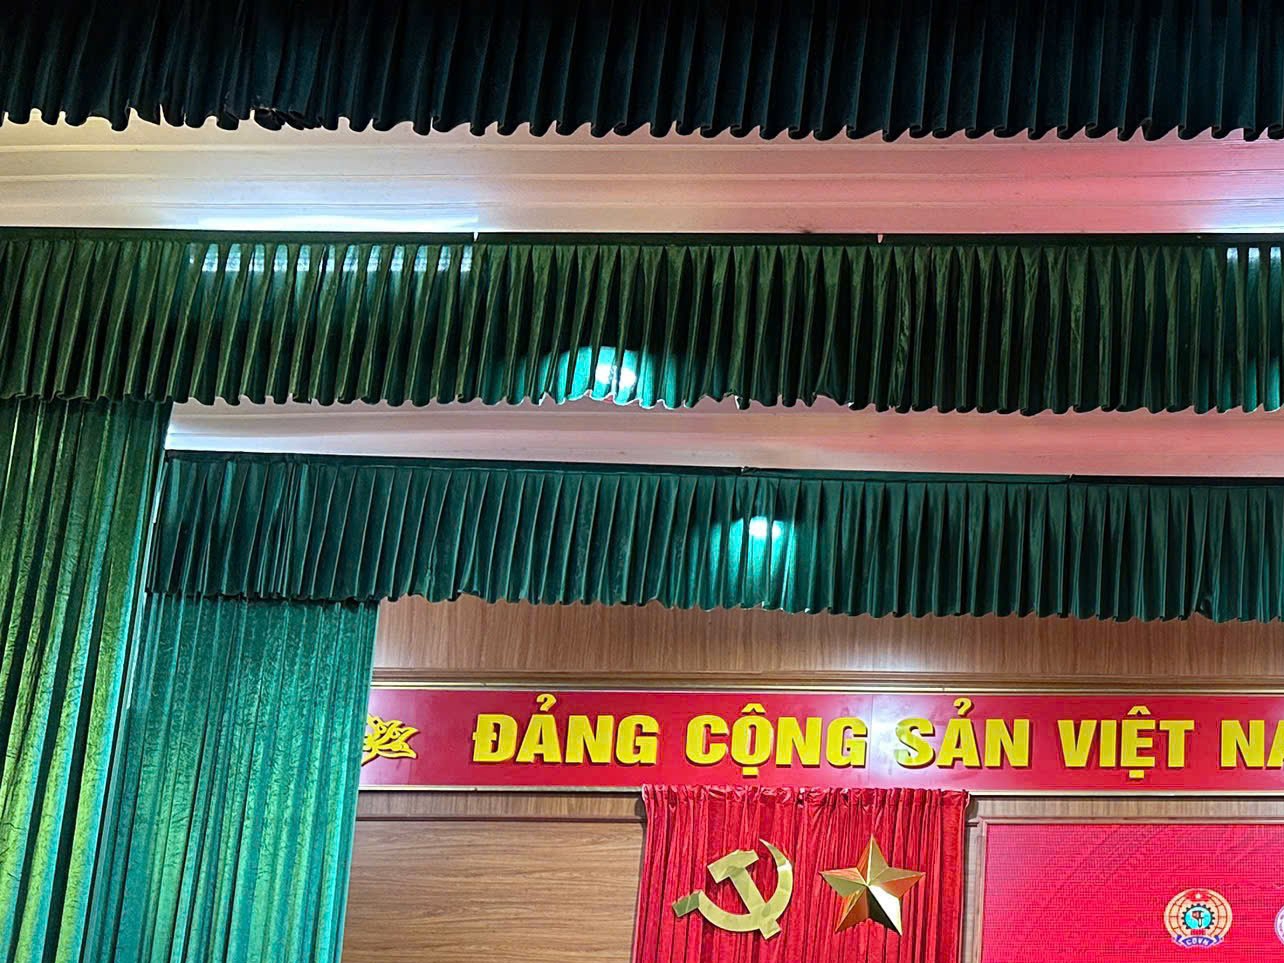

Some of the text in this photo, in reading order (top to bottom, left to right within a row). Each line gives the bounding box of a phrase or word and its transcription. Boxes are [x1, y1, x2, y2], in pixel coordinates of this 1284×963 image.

[472, 693, 658, 765] ĐẢNG
[685, 703, 868, 776] CỘNG
[895, 697, 1030, 768] SẢN
[1057, 705, 1195, 779] VIỆT
